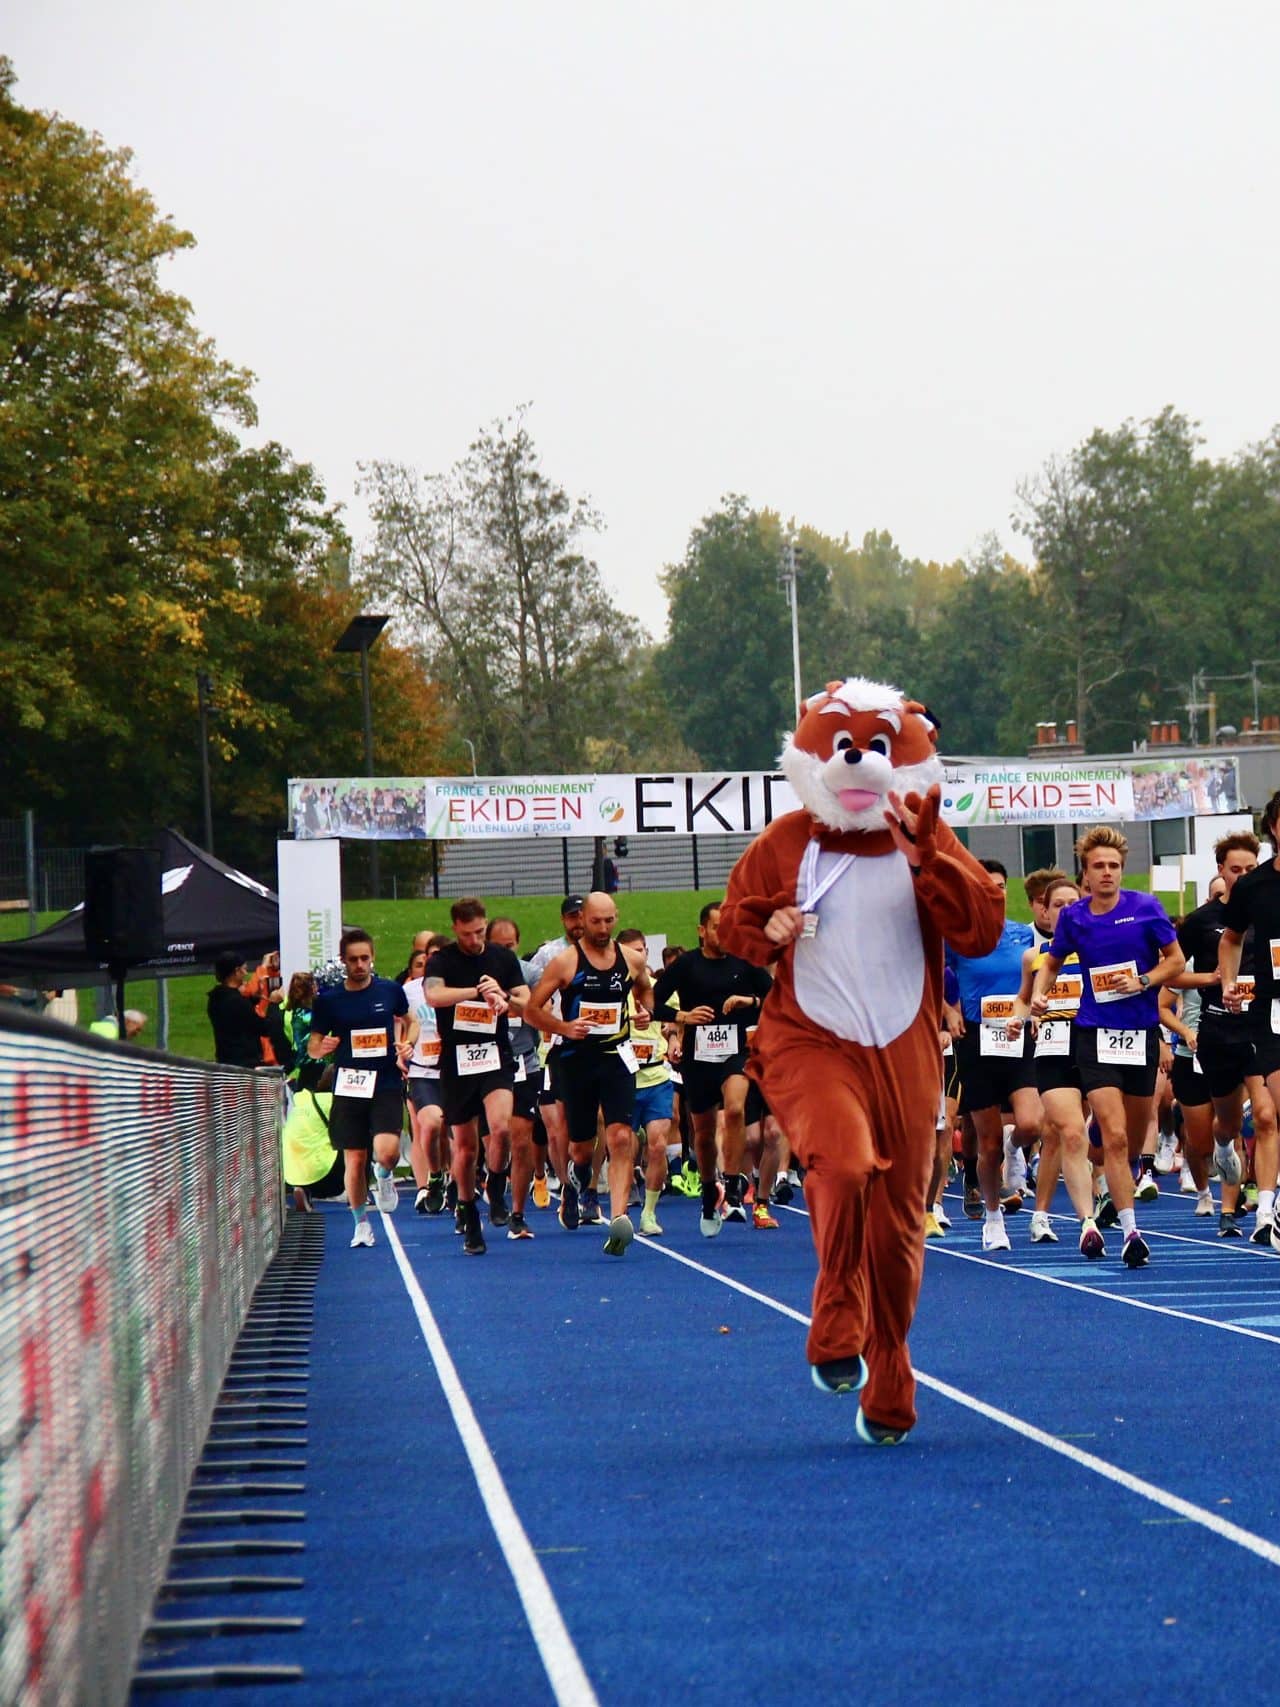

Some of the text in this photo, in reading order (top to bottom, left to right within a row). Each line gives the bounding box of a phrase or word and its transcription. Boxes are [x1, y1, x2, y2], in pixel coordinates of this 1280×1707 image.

[975, 773, 1021, 784] FRANCE
[1026, 771, 1128, 782] ENVIRONNEMENT
[435, 783, 595, 797] FRANCE ENVIRONNEMENT
[988, 783, 1117, 809] EKIDEN
[449, 796, 583, 822] EKIDEN
[1000, 807, 1107, 821] VILLENEUVE D'ASCQ
[461, 823, 530, 833] VILLENEUVE
[707, 1031, 728, 1042] 484
[1044, 1028, 1052, 1041] 8
[1109, 1036, 1134, 1050] 212
[467, 1049, 488, 1061] 327
[347, 1074, 367, 1086] 547
